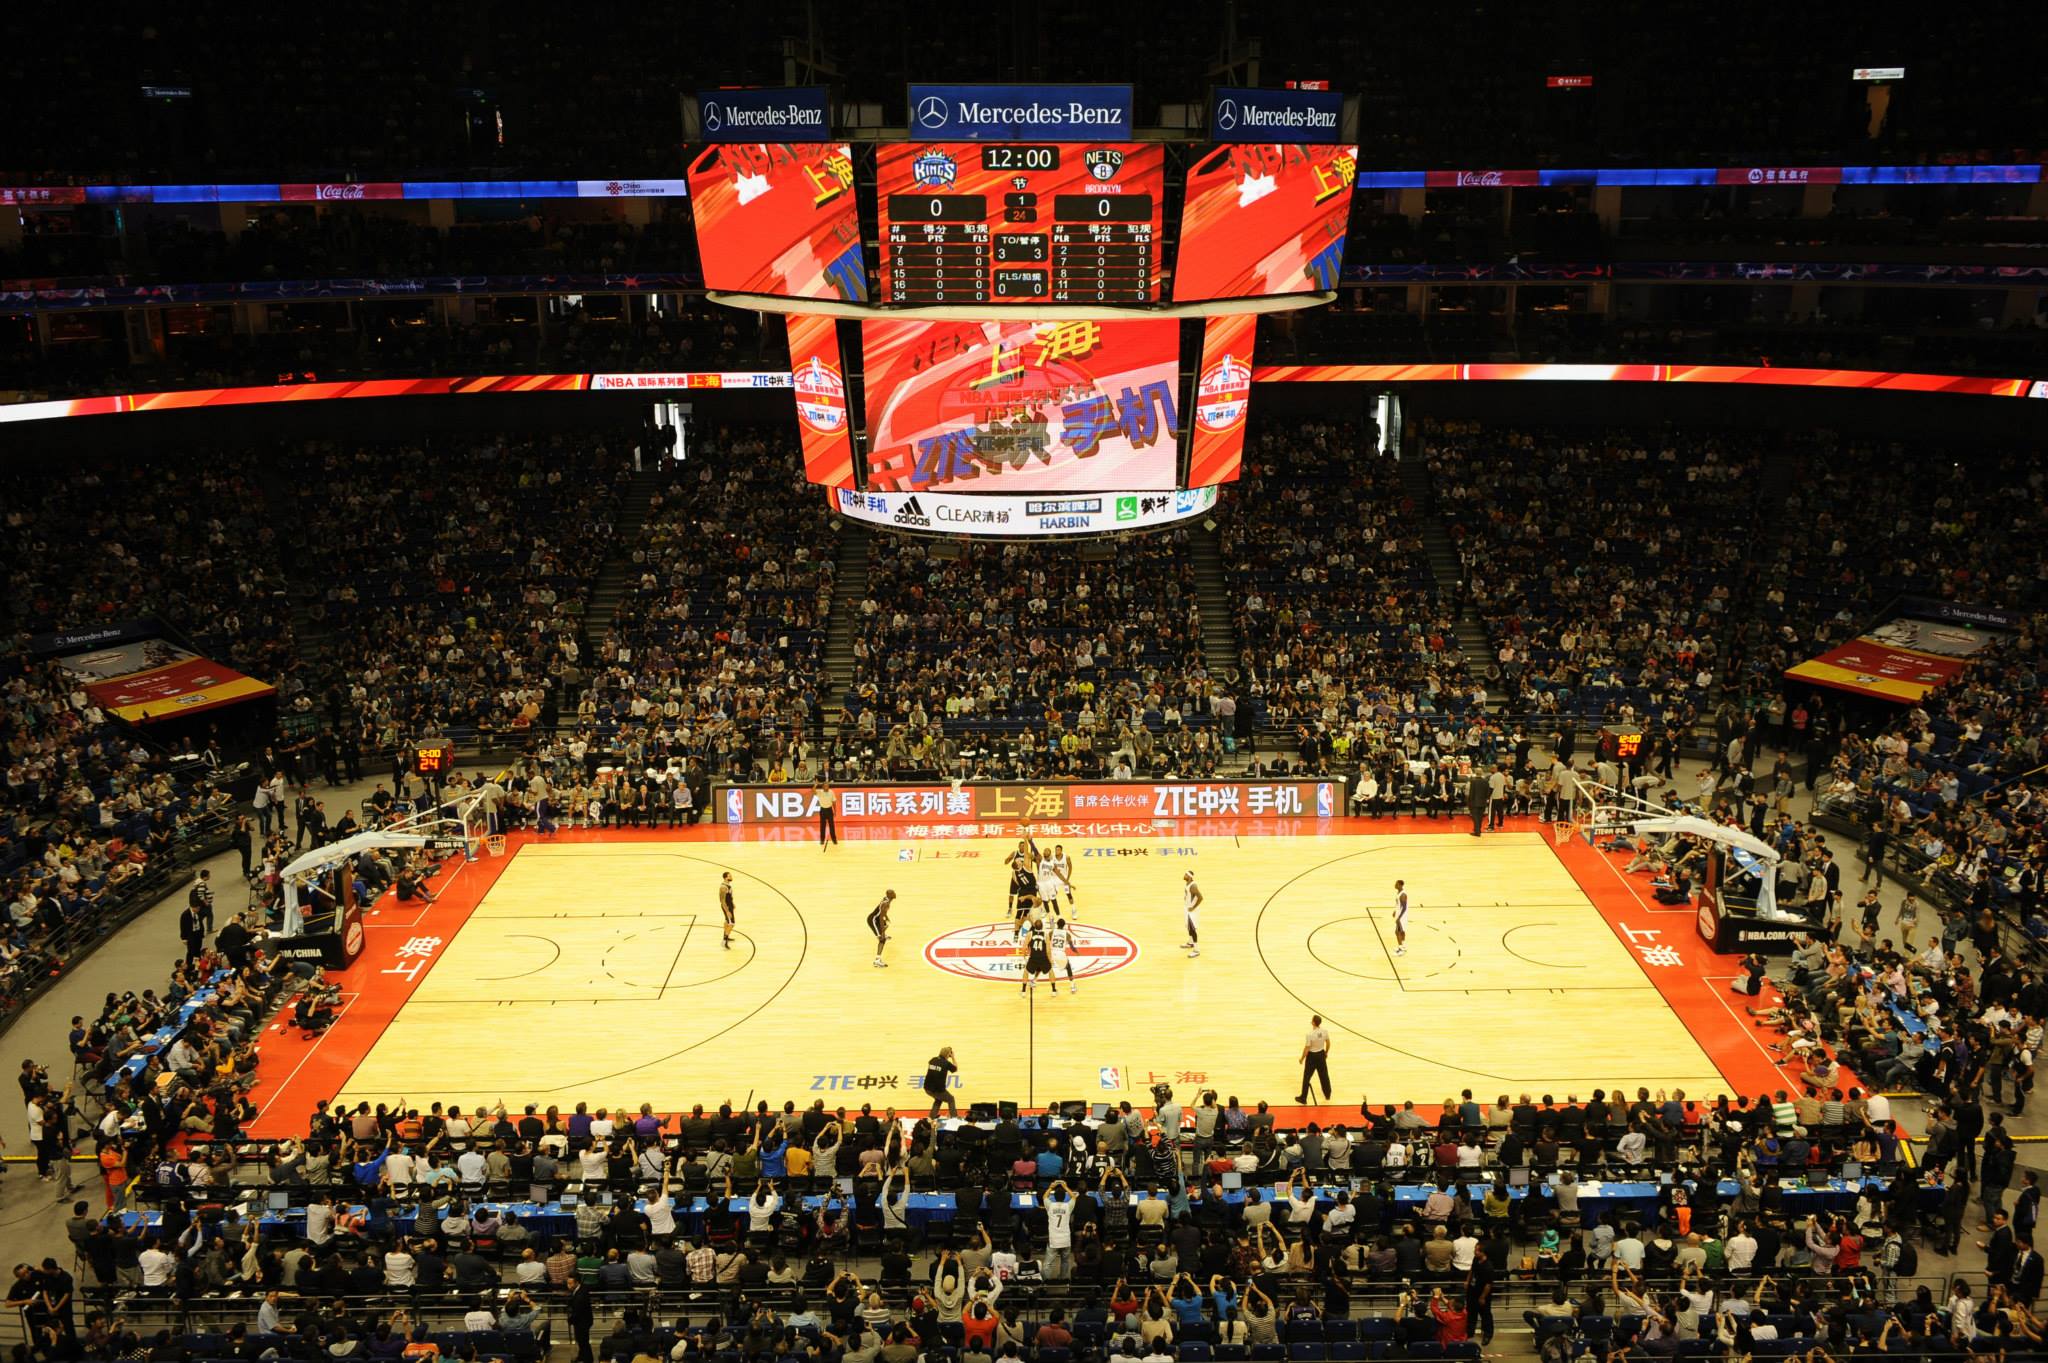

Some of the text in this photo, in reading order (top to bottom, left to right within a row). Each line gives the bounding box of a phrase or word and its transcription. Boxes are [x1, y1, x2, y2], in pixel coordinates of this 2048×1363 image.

[726, 104, 822, 127] Mercedes-Benz
[958, 102, 1122, 124] Mercedes-Benz
[1242, 105, 1337, 127] Mercedes-Benz
[988, 149, 1052, 167] 12:00
[1086, 150, 1122, 165] NETS
[914, 162, 955, 181] KINGS
[930, 199, 943, 216] 0
[1018, 196, 1025, 206] 1
[1098, 199, 1110, 217] 0
[1013, 210, 1026, 220] 24
[890, 234, 988, 242] PLR PTS FLS
[1053, 234, 1150, 242] PLR PTS FLS
[897, 246, 982, 254] 7 0 0
[998, 248, 1042, 259] 3 3
[1060, 246, 1146, 254] 2 0 0
[897, 257, 982, 266] 8 0 0
[1061, 257, 1145, 266] 7 0 0
[894, 269, 983, 278] 15 0 0
[1060, 269, 1145, 278] 8 0 0
[894, 280, 983, 289] 16 0 0
[998, 283, 1041, 294] 0 0
[1058, 280, 1145, 289] 11 0 0
[894, 291, 983, 300] 34 0 0
[1056, 291, 1145, 300] 44 0 0
[969, 320, 1101, 389] 上海
[606, 377, 634, 387] NBA
[688, 375, 721, 388] 上海
[1177, 489, 1200, 509] SAP
[893, 513, 931, 527] adidas
[1039, 516, 1090, 529] HARBIN
[1618, 743, 1638, 757] 24
[420, 758, 440, 770] 24
[841, 791, 971, 817] 国际系列赛
[980, 786, 1065, 818] 上海
[1073, 794, 1150, 809] 首席合作伙伴
[1247, 784, 1302, 815] 手机
[1033, 940, 1043, 952] 44
[1052, 938, 1065, 949] 23
[1136, 1070, 1209, 1085] 上海
[1420, 1153, 1427, 1167] 2
[1075, 1161, 1082, 1175] 2
[1056, 1214, 1063, 1228] 7
